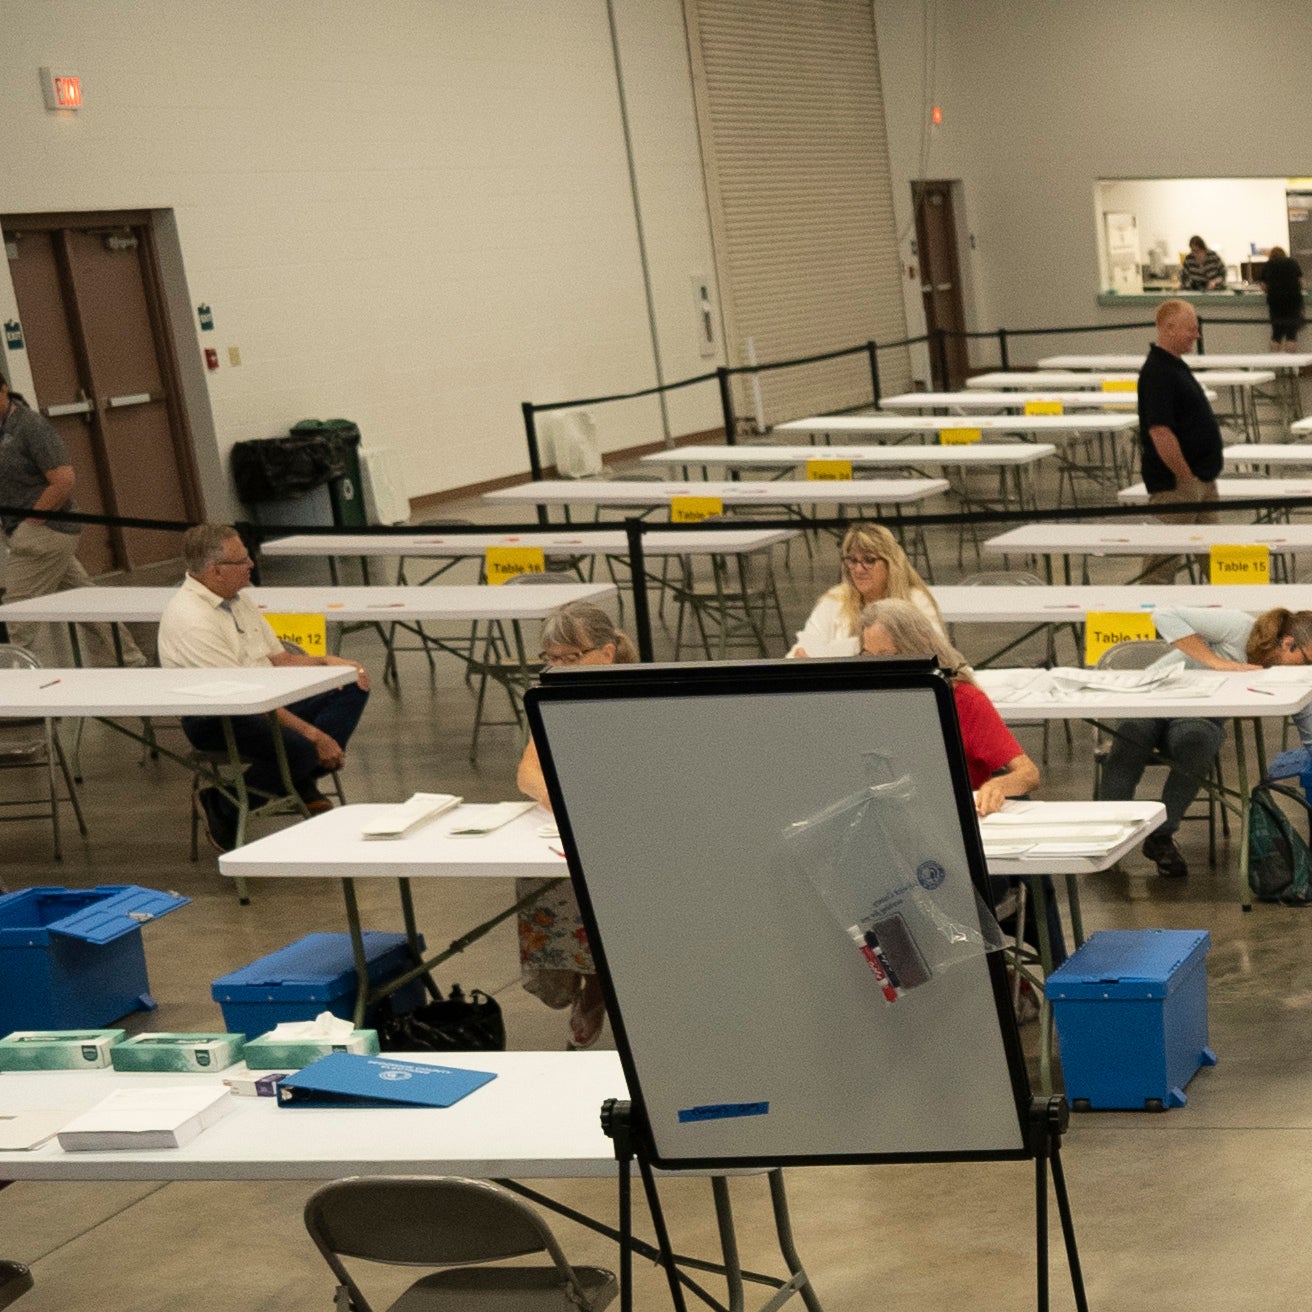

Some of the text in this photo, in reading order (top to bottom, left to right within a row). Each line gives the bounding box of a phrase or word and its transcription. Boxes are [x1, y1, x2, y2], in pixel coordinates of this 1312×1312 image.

[494, 562, 524, 574] Table
[1217, 561, 1266, 572] Table 15
[307, 633, 322, 645] 12
